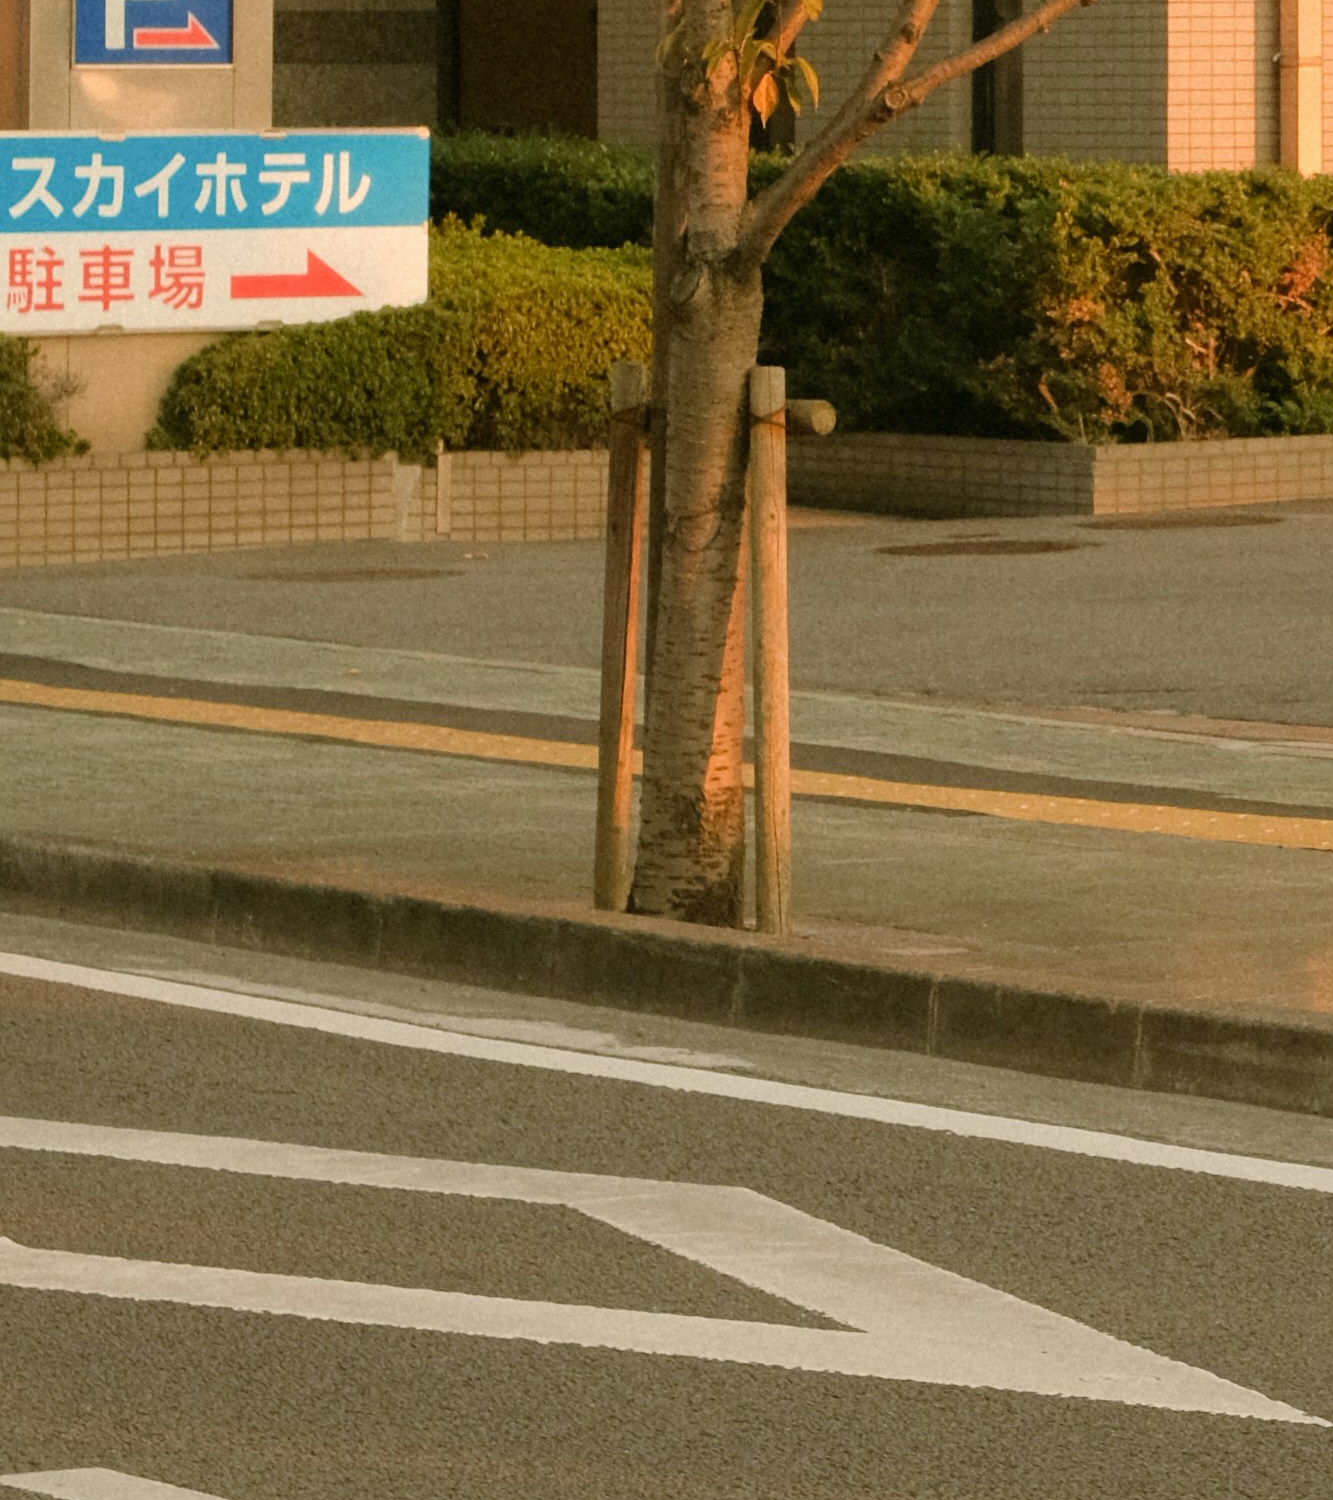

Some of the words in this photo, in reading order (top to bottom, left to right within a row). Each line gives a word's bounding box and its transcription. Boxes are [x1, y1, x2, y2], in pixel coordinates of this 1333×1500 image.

[8, 151, 371, 219] スカイホテル
[7, 243, 206, 314] 駐車場
